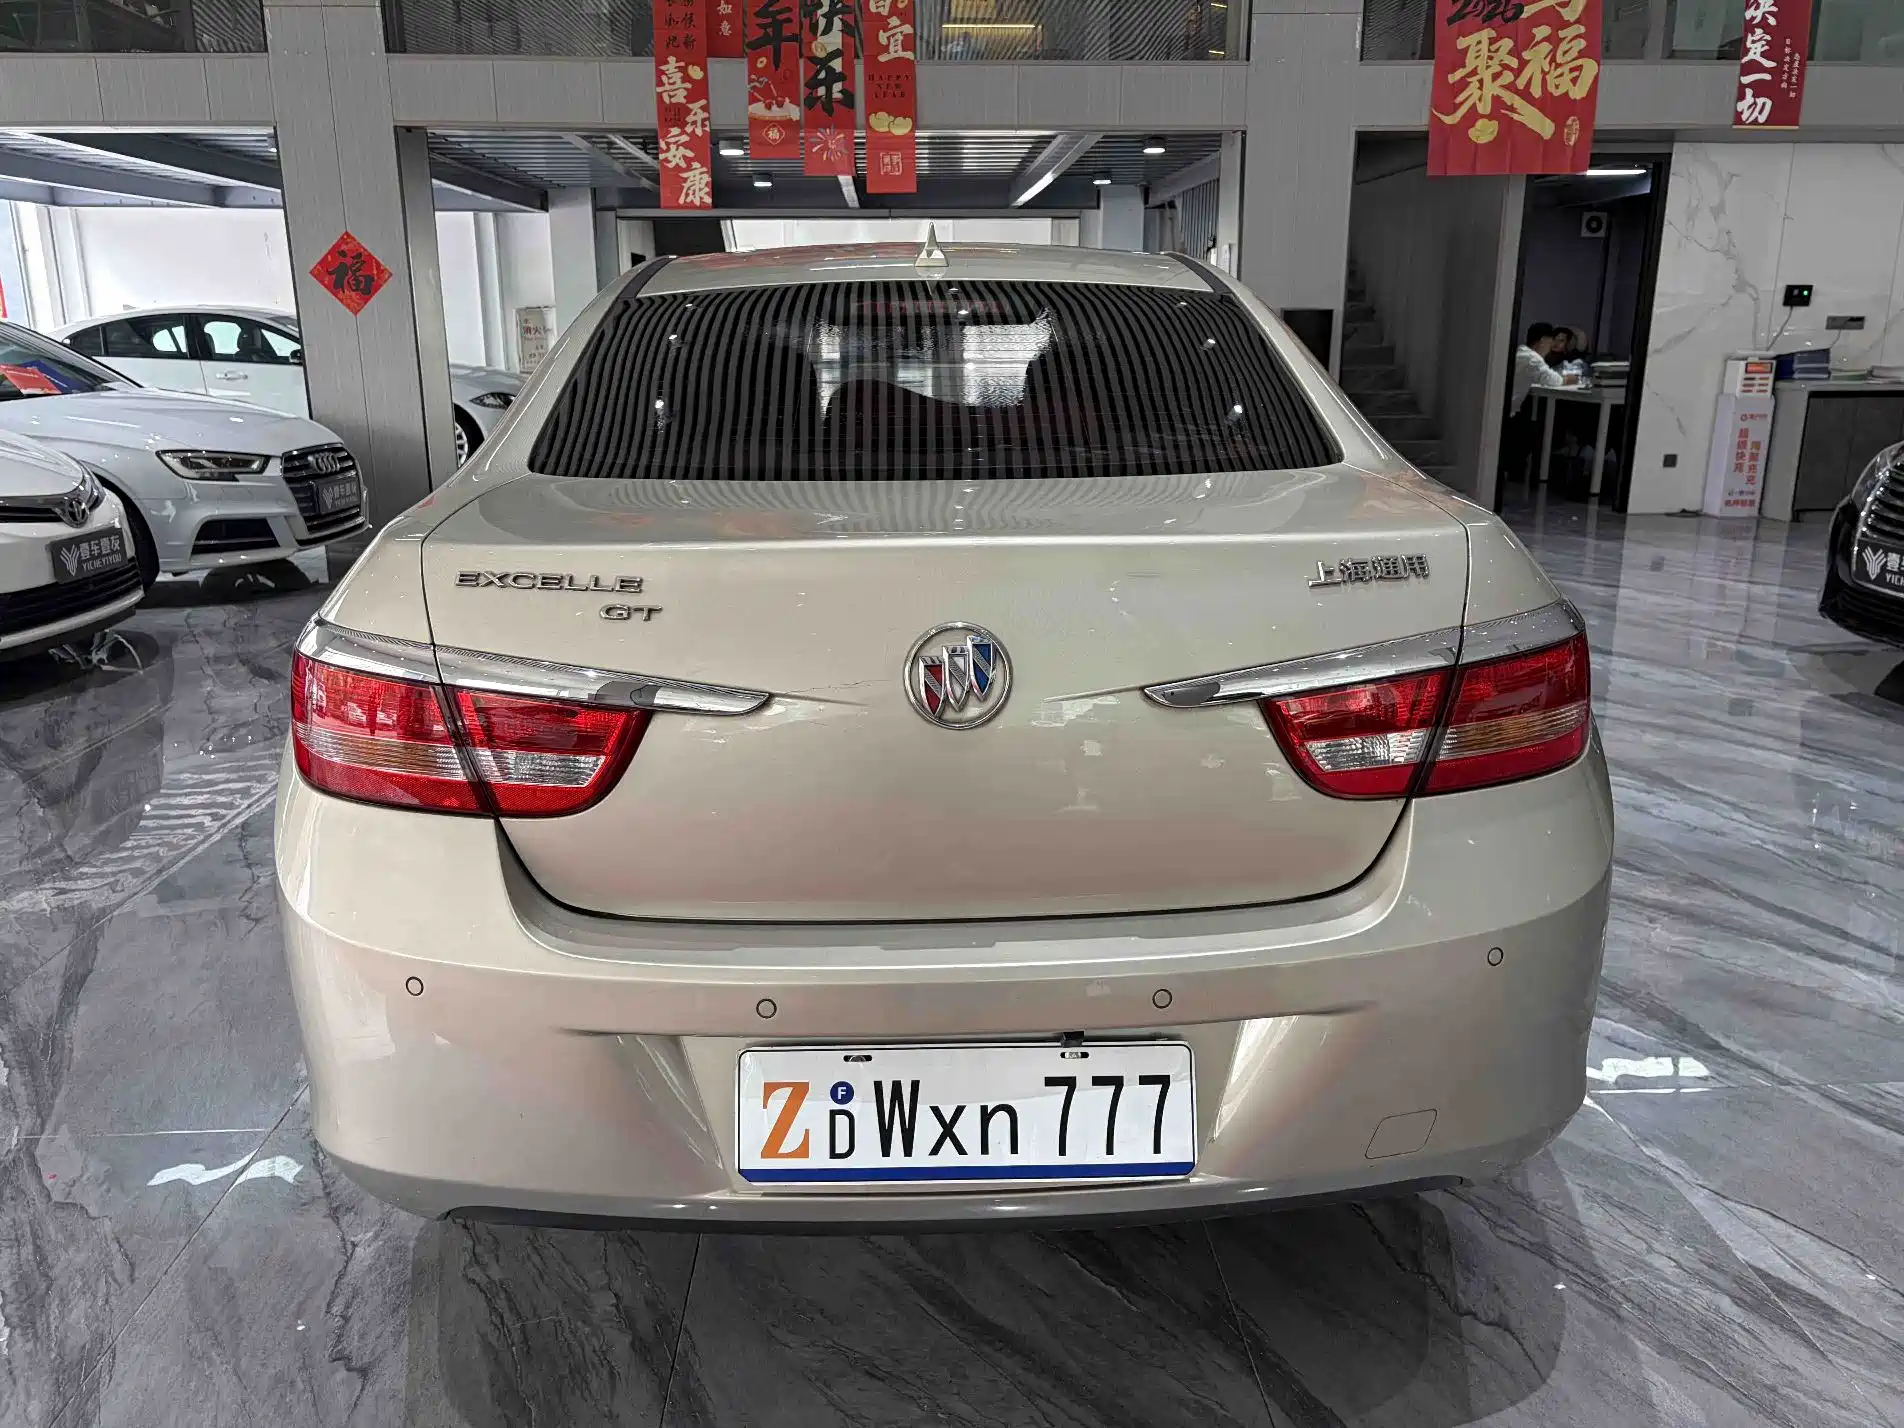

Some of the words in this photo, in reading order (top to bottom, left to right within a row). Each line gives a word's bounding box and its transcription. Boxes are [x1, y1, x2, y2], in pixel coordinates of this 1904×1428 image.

[717, 0, 732, 36] 如意
[746, 0, 802, 70] 年
[1736, 0, 1778, 124] 决定一切
[656, 56, 712, 206] 喜乐安康
[326, 250, 375, 296] 福
[80, 535, 121, 560] 壹车壹友
[455, 571, 643, 594] EXCELLE
[1308, 554, 1430, 588] 上海通用
[599, 604, 663, 621] GT
[760, 1081, 810, 1159] Z
[829, 1109, 856, 1159] D
[873, 1079, 1019, 1158] Wxn
[1044, 1074, 1171, 1156] 777
